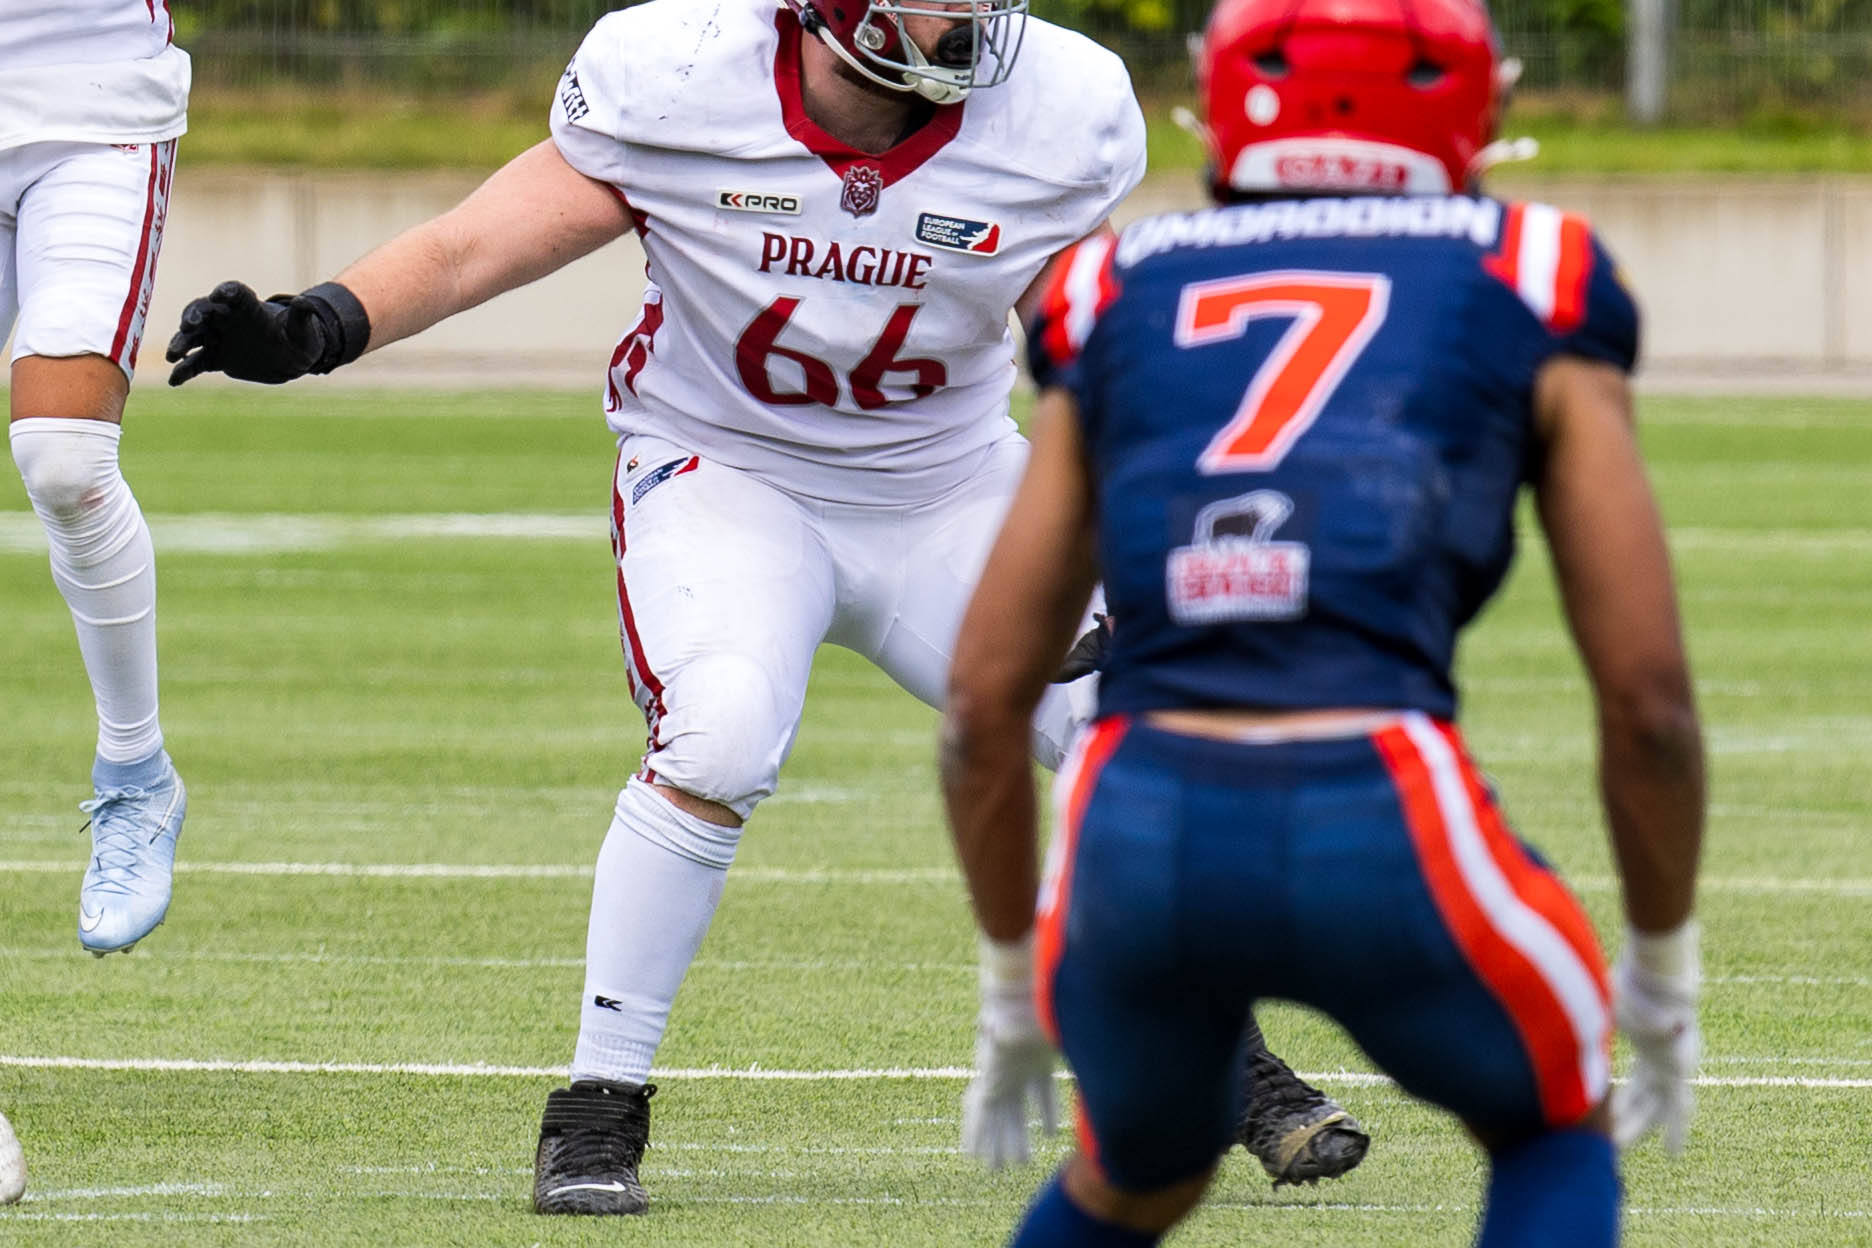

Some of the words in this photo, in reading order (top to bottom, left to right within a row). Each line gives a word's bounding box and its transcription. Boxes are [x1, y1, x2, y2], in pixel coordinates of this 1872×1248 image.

[921, 231, 960, 245] FOOTBALL
[924, 216, 965, 230] EUROPEAN
[758, 232, 933, 290] PRAGUE
[734, 295, 948, 411] 66
[1174, 269, 1392, 476] 7
